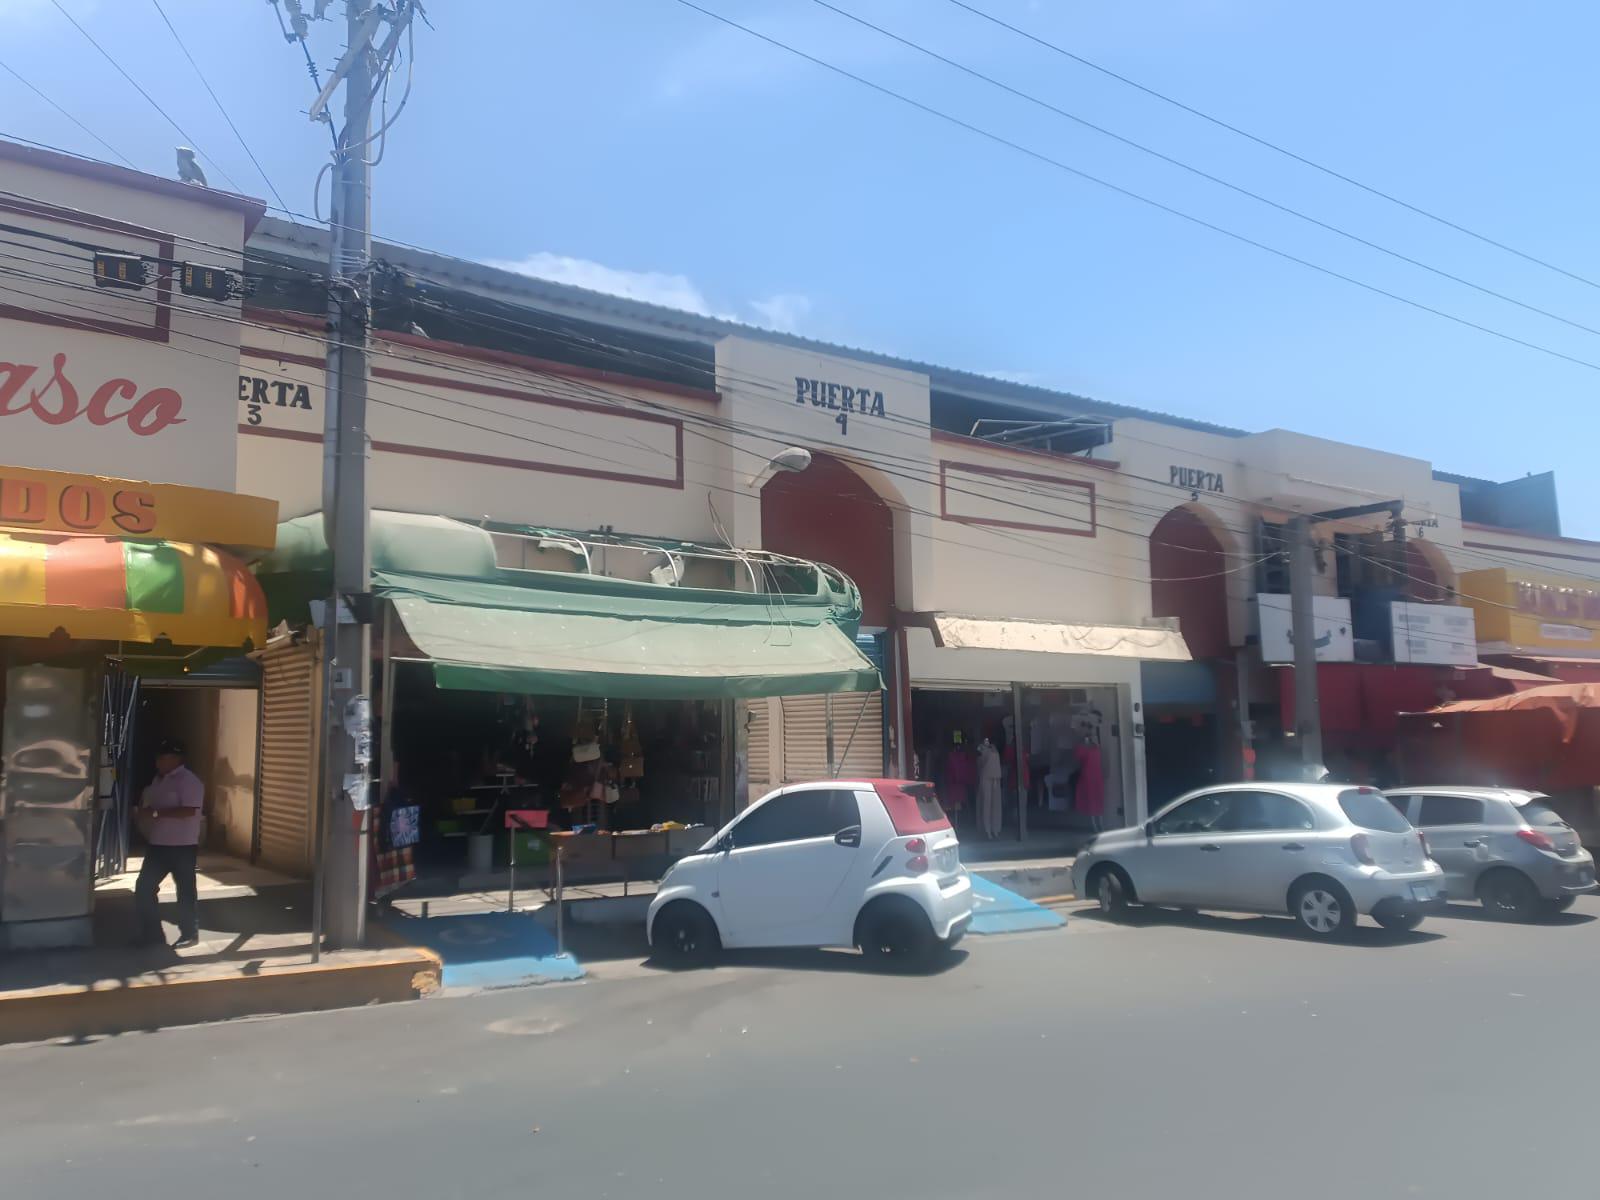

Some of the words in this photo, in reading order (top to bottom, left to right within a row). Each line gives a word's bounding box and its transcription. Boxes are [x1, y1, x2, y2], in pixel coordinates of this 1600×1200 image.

[795, 377, 885, 417] PUERTA
[247, 404, 262, 425] 3
[1169, 465, 1224, 493] PUERTA
[0, 478, 157, 534] DOS
